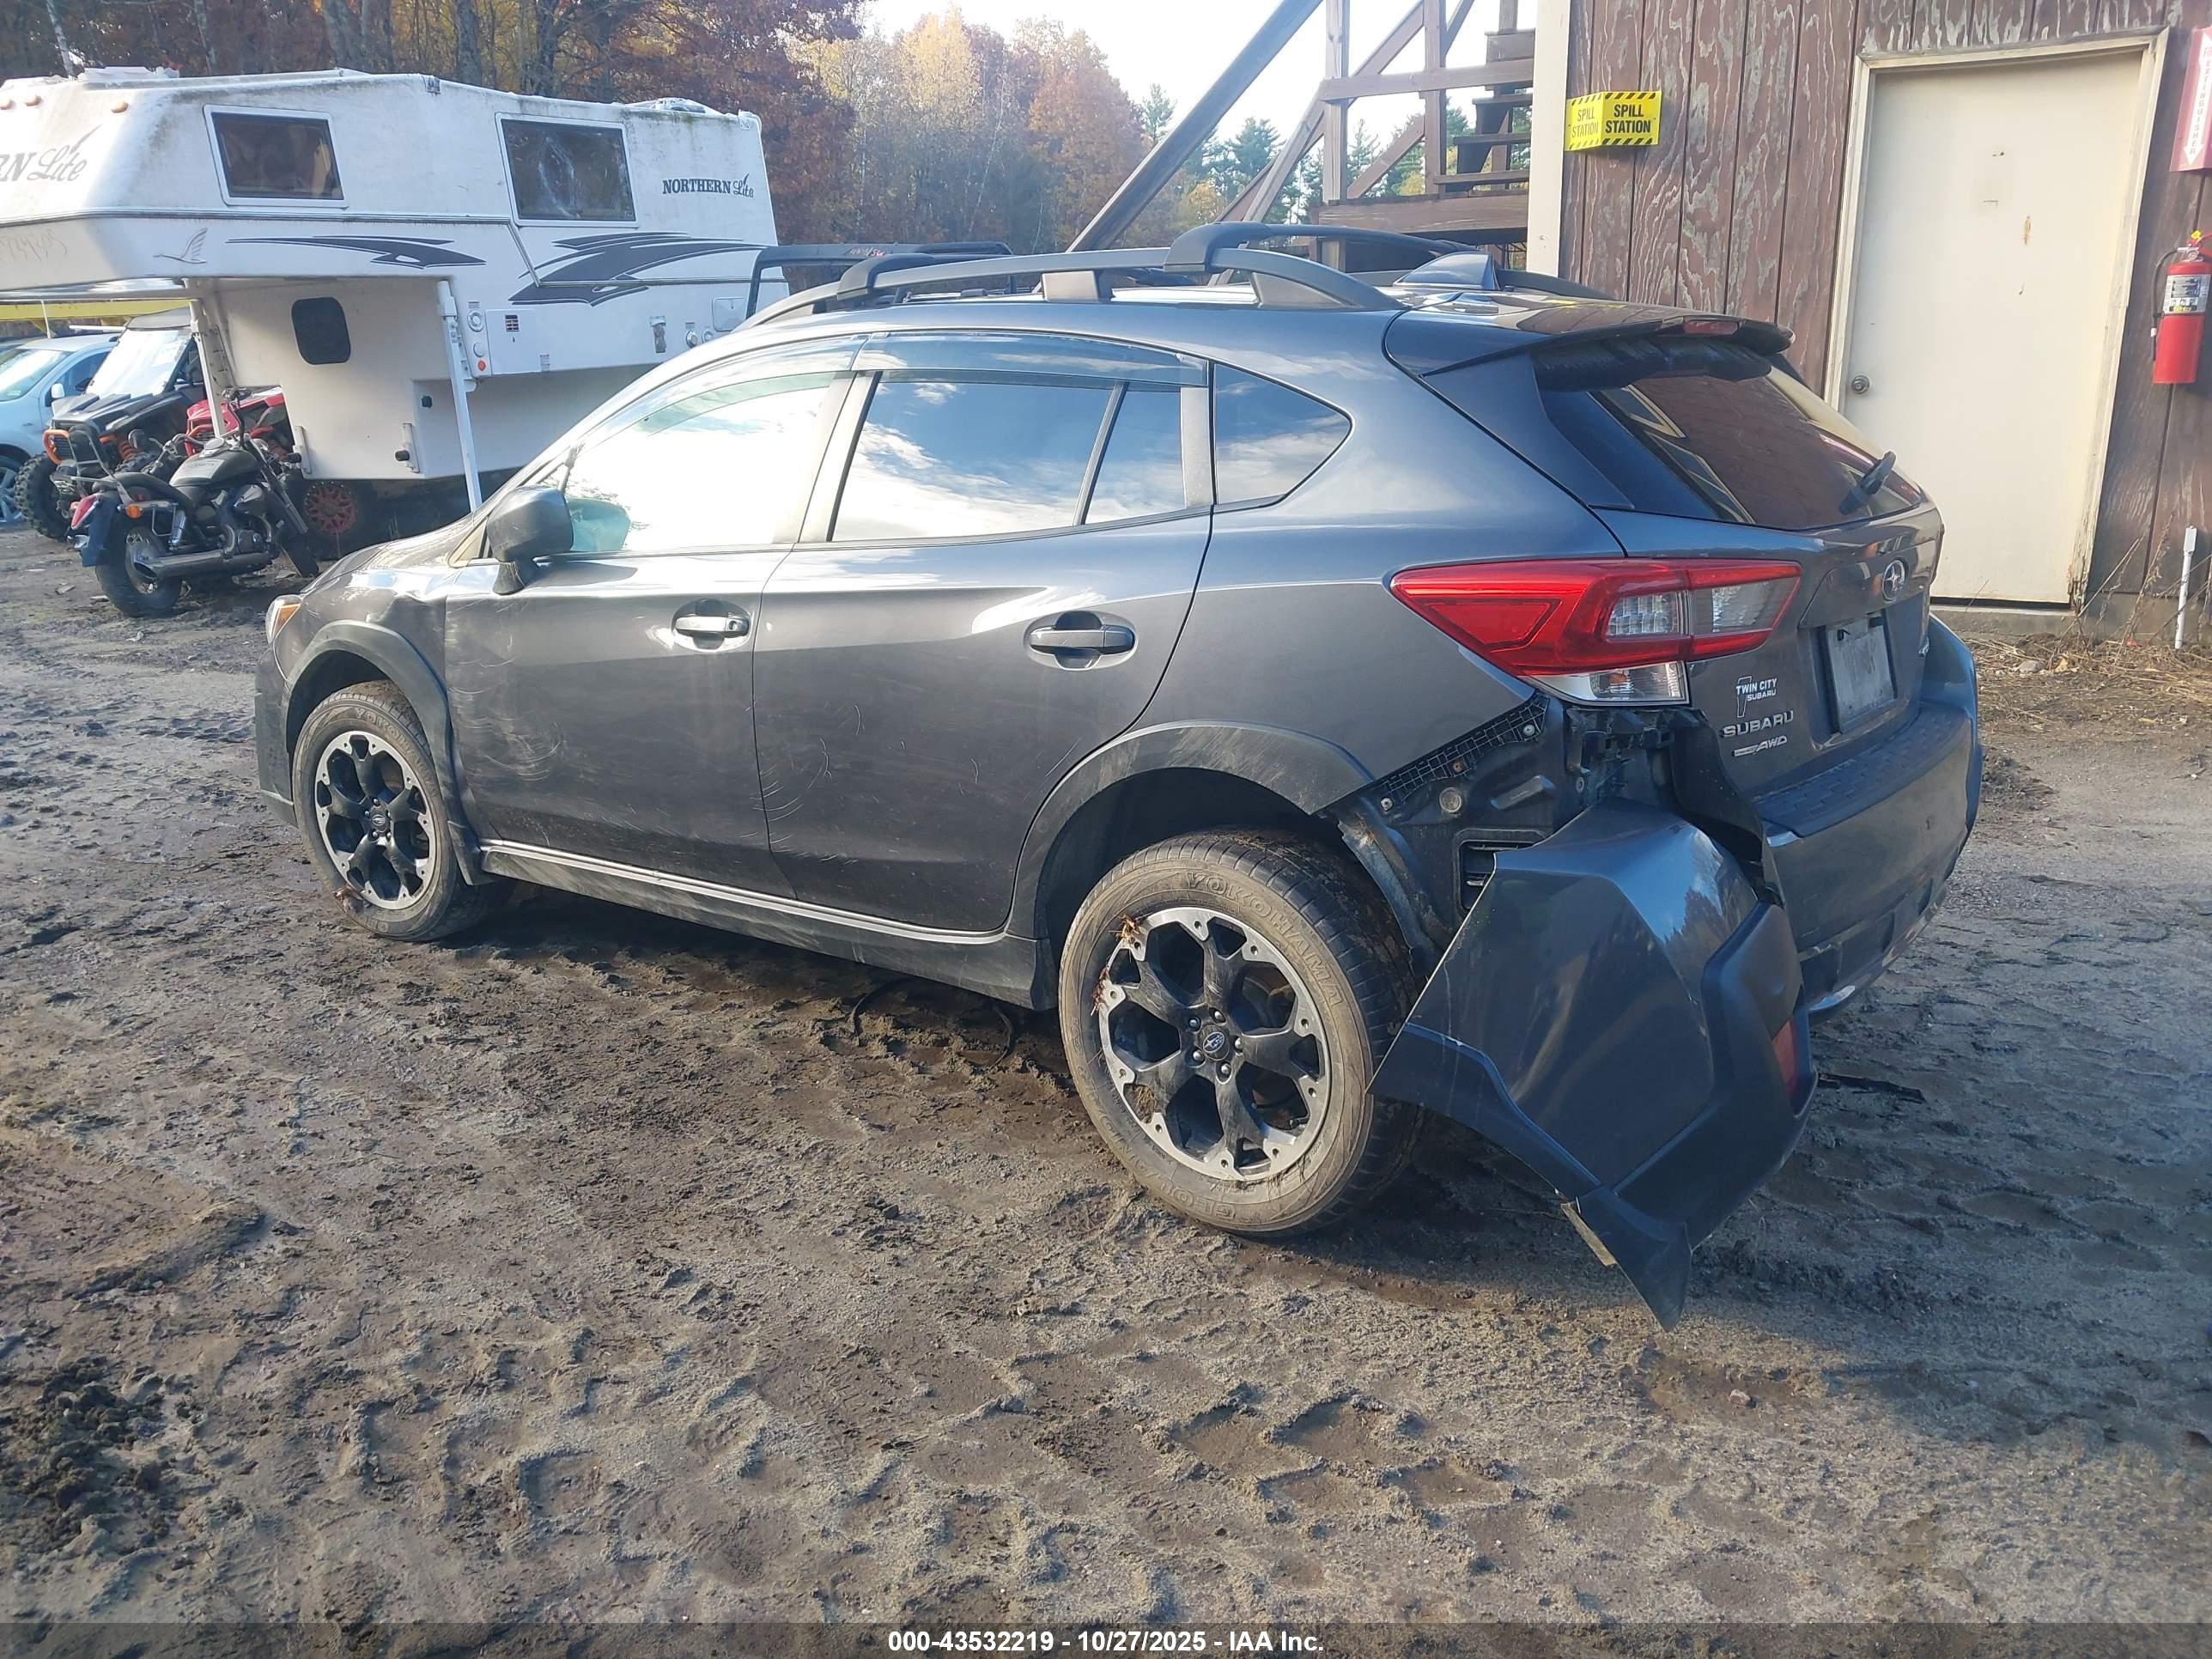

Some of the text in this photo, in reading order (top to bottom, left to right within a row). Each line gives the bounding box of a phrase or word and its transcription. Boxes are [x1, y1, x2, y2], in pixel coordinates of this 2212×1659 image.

[1577, 106, 1595, 122] SPILL
[1614, 104, 1644, 118] SPILL
[1572, 122, 1599, 138] STATION
[1606, 120, 1651, 133] STATION
[27, 125, 101, 182] Lite
[662, 173, 754, 198] NORTHERN Lite
[1735, 678, 1778, 695] TWIN CITY
[1747, 690, 1777, 702] SUBARU
[1721, 709, 1795, 738] SUBARU
[1755, 735, 1789, 752] AWD
[1186, 871, 1345, 1007] YOKOHAMA
